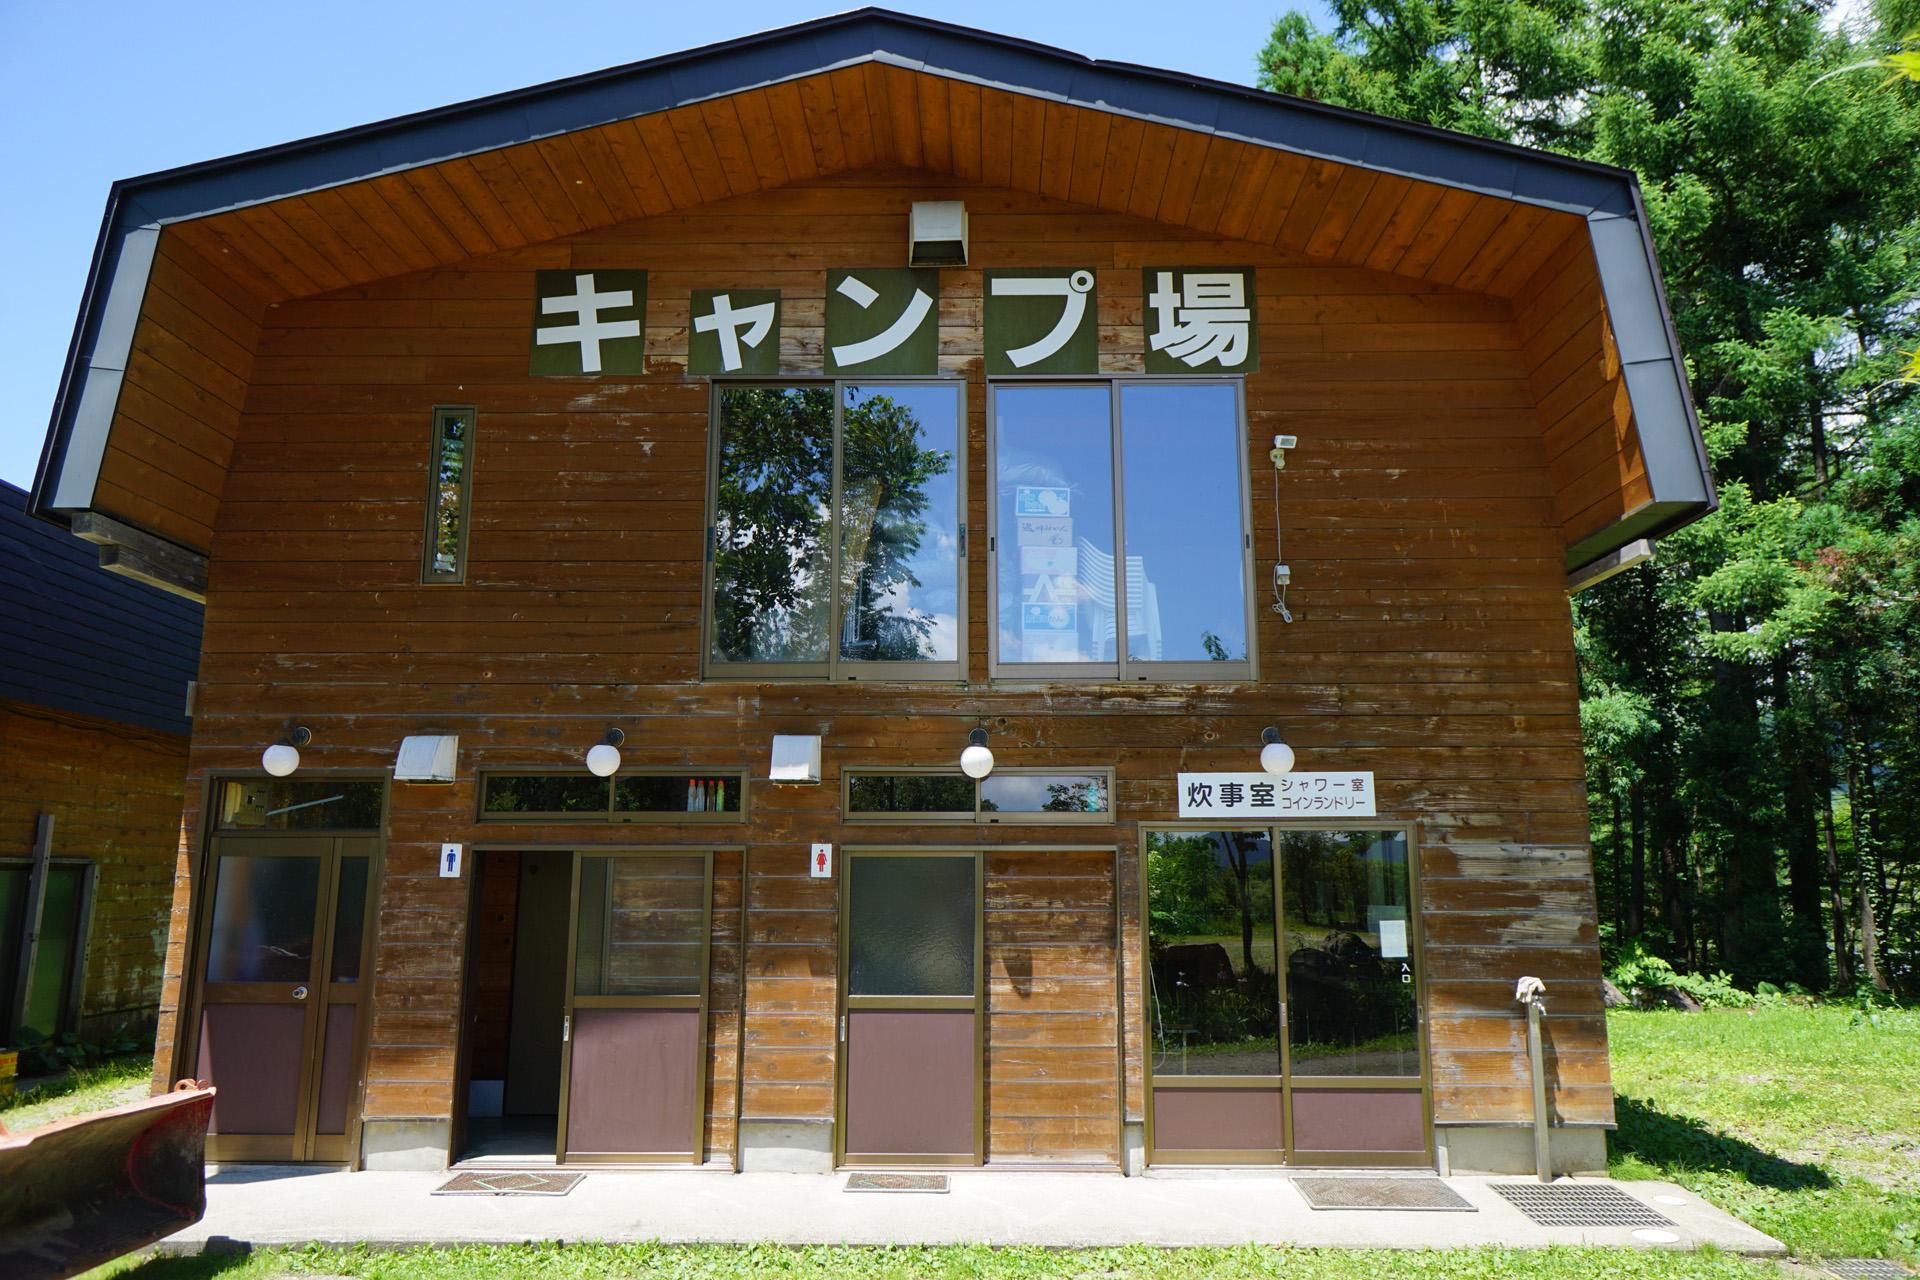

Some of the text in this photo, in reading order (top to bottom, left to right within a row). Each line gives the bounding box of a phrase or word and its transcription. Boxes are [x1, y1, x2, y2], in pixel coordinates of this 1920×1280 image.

[536, 269, 1251, 373] キャンプ場
[1187, 781, 1276, 808] 炊事室
[1281, 777, 1365, 792] シャワー室
[1281, 795, 1366, 811] コインランドリー
[1401, 963, 1411, 983] 入口
